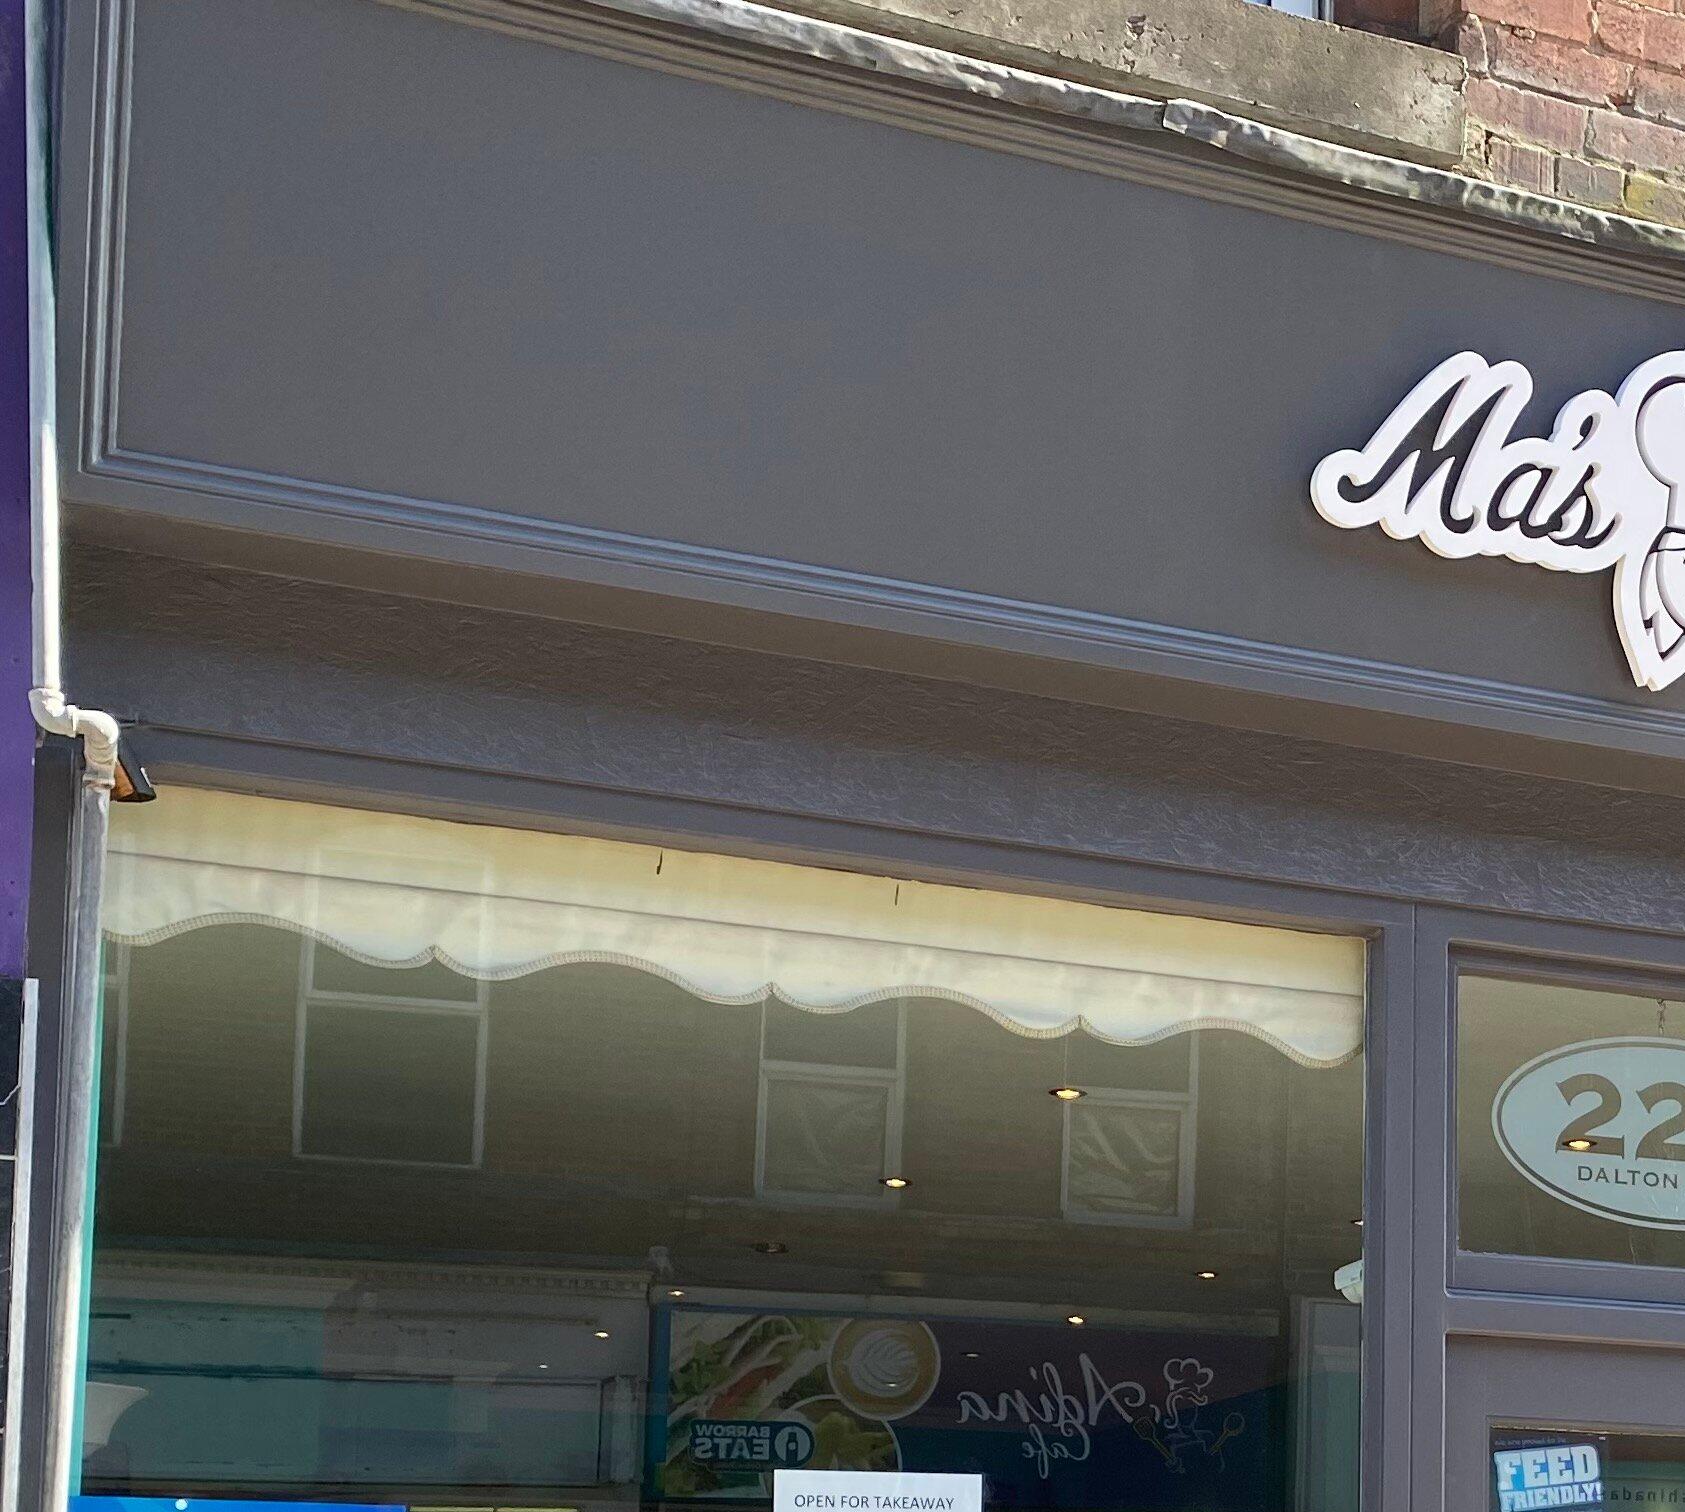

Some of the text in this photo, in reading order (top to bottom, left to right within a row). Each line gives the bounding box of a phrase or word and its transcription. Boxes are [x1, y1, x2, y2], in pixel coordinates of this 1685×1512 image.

[1337, 371, 1624, 550] Ma's
[1577, 1164, 1679, 1190] DALTON
[1494, 1445, 1599, 1490] FEED
[794, 1494, 955, 1511] OPEN FOR TAKEAWAY
[1500, 1481, 1602, 1512] FRIENDLY!
